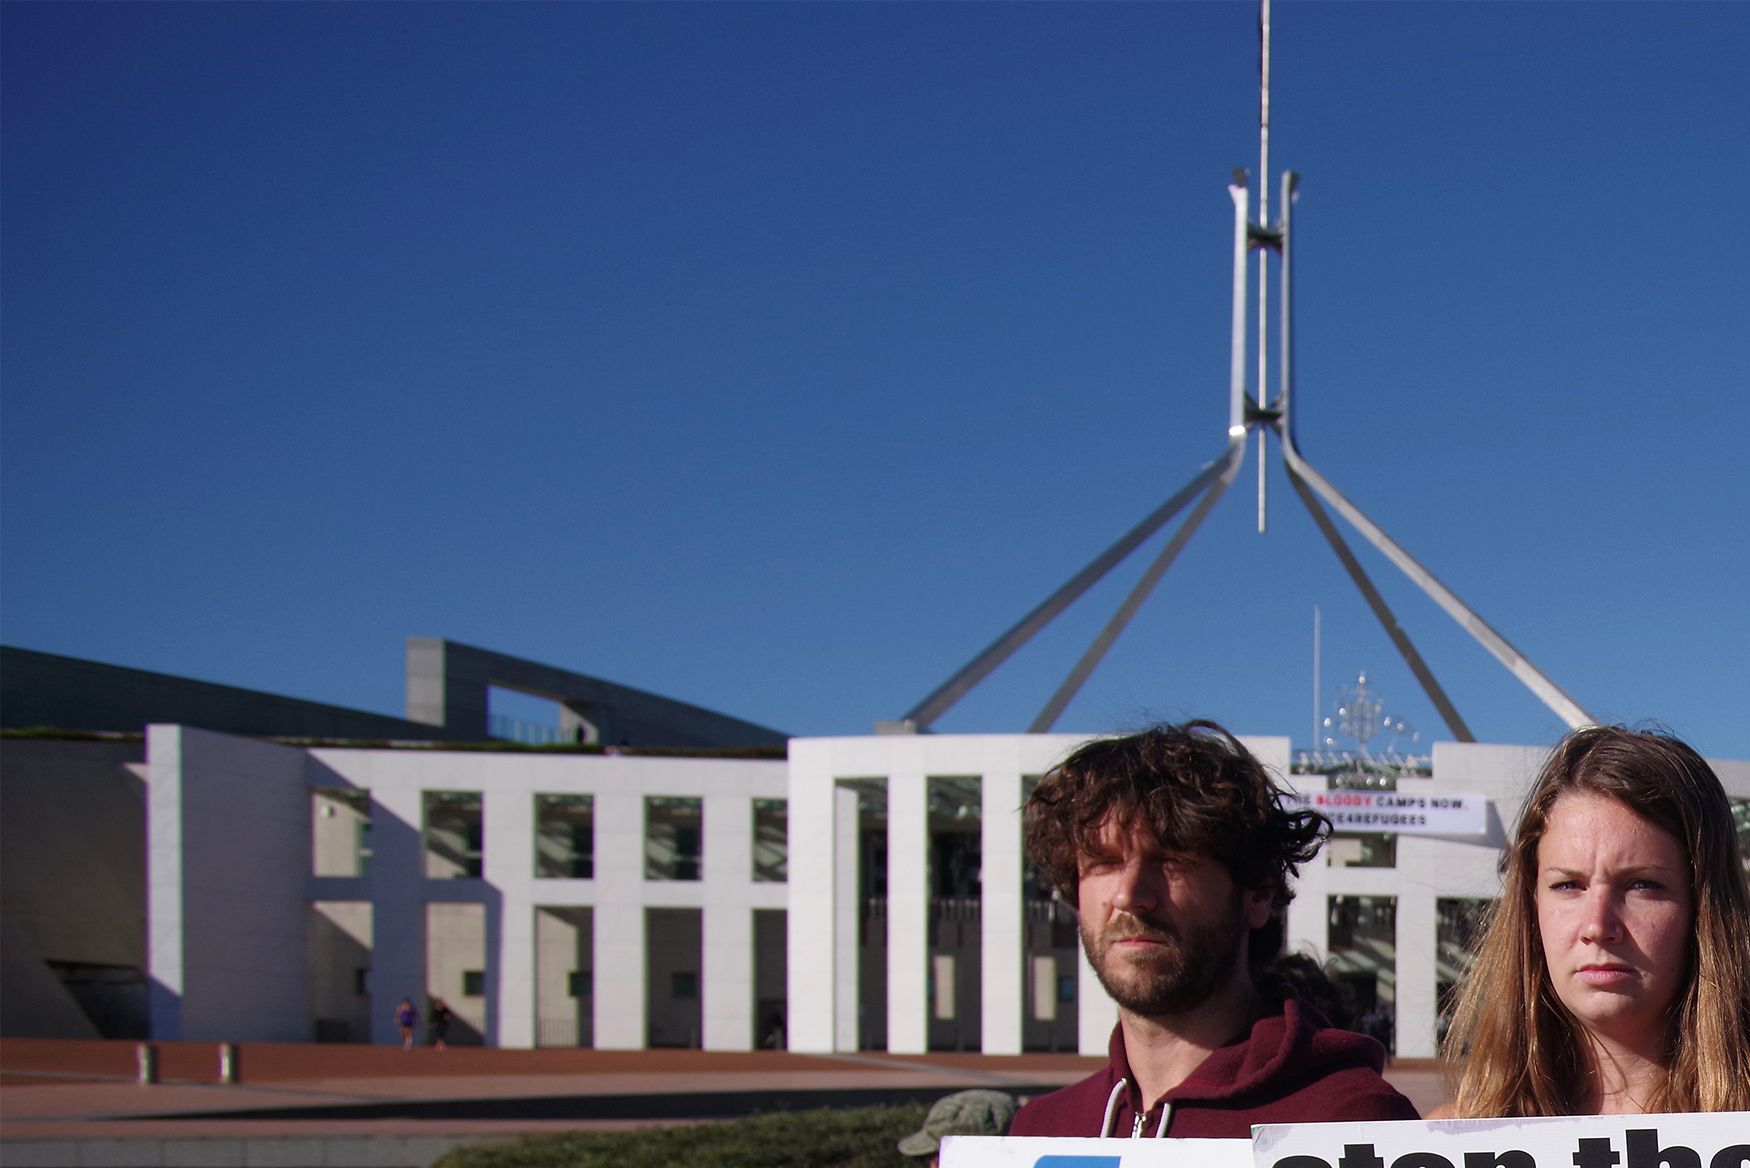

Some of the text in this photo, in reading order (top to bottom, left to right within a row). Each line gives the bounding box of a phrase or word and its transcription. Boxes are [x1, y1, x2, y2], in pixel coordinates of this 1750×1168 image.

[1316, 794, 1372, 806] BLOODY
[1376, 796, 1426, 808] CAMPS
[1323, 812, 1426, 825] CE4REFUGEES
